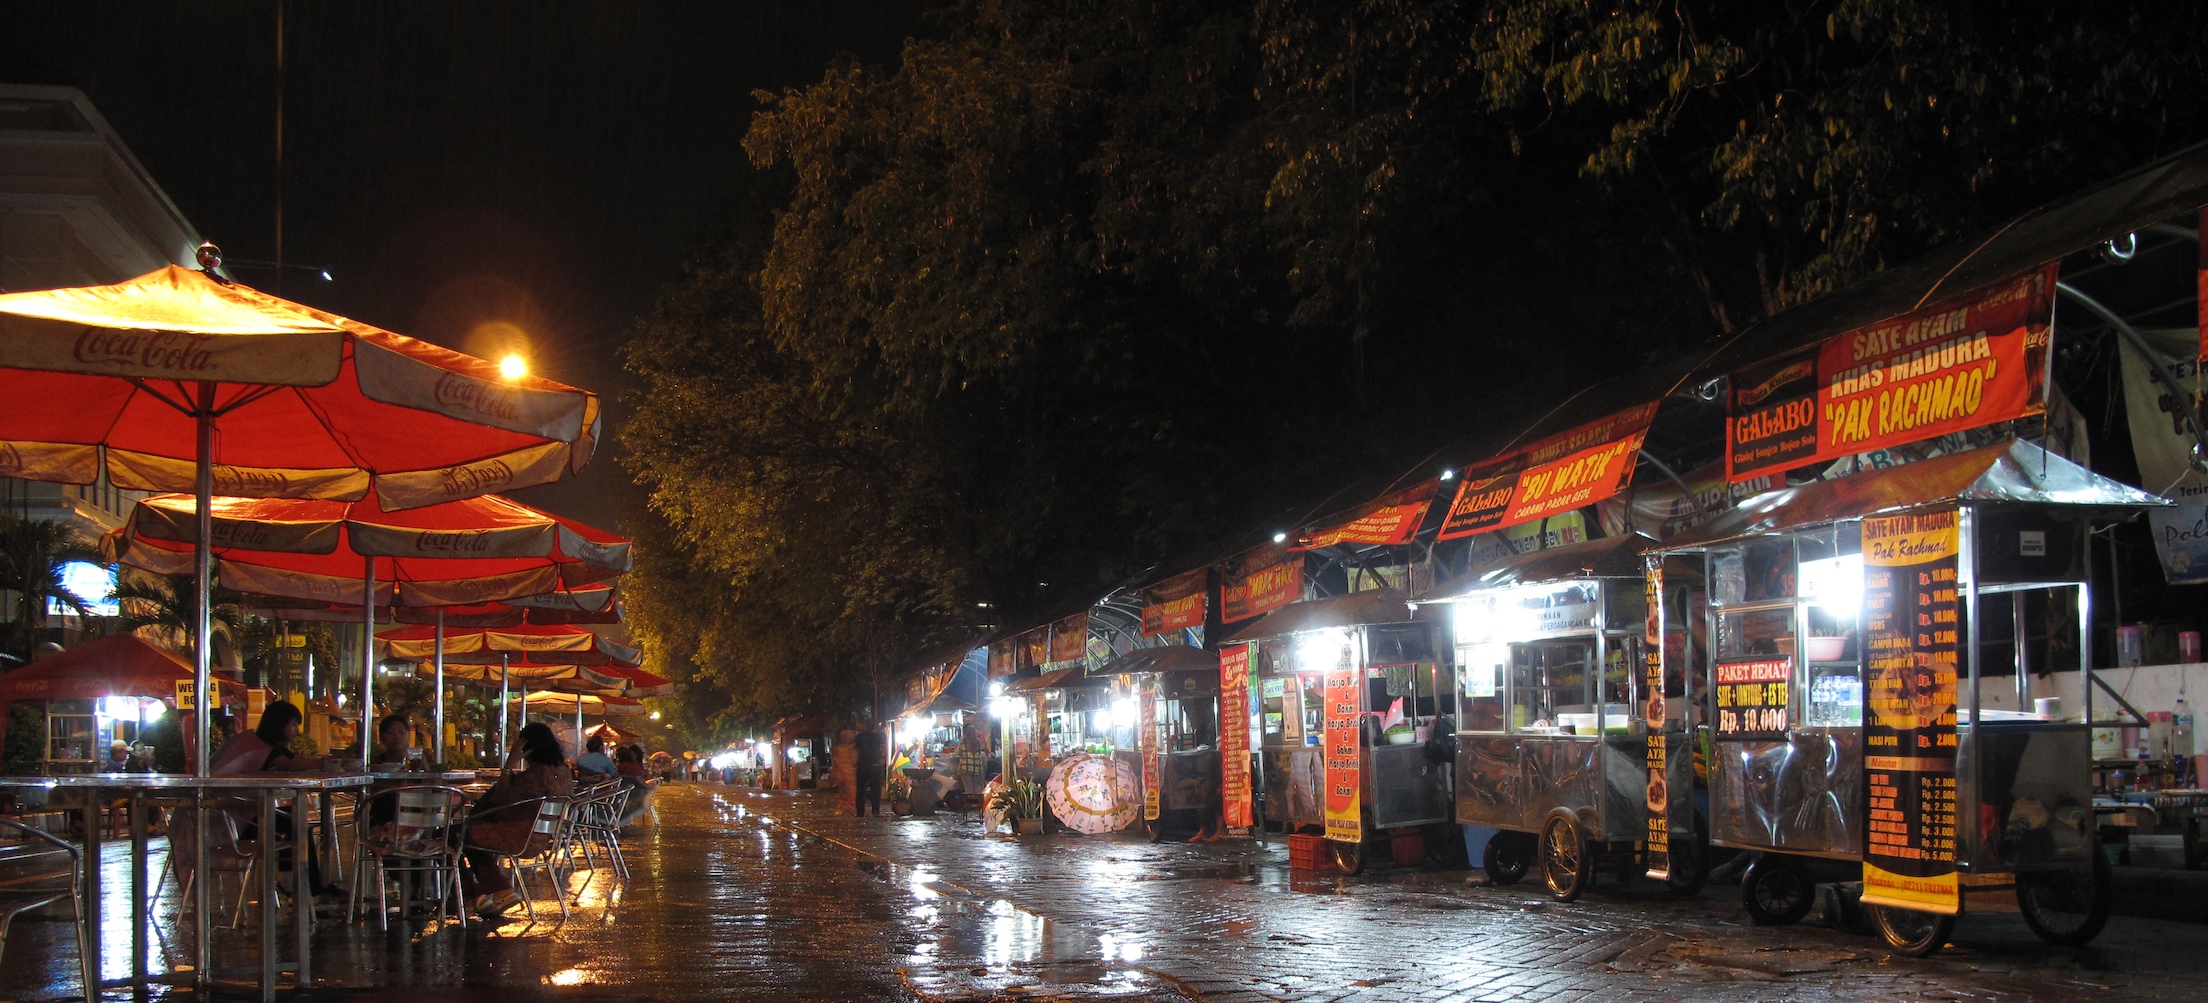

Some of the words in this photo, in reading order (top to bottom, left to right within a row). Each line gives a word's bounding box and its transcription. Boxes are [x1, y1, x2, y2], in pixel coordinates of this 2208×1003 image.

[1853, 323, 1903, 362] SATE
[1905, 306, 1969, 347] AYAM
[73, 327, 218, 371] Coca-Cola
[1830, 360, 1884, 400] KHAS
[1889, 330, 1992, 383] MADURA
[2149, 363, 2185, 384] STE
[434, 371, 518, 421] Coca-Cola
[1736, 397, 1815, 444] GALABO
[1825, 395, 1873, 446] "PAK
[1522, 469, 1552, 504] "BU
[1550, 441, 1626, 495] WATIK"
[1456, 487, 1513, 516] GALABO
[1545, 494, 1573, 512] PASAR
[1571, 487, 1593, 504] GEDE
[1866, 519, 1888, 540] SATE
[1889, 515, 1914, 537] AYAM
[1917, 511, 1955, 532] MADURA
[416, 530, 492, 553] Coca-Cola
[1873, 541, 1895, 561] Pak
[1897, 535, 1949, 558] Rachmad
[521, 636, 560, 648] Coca-Cola
[1225, 665, 1233, 681] &
[1718, 664, 1750, 682] PAKET
[1751, 662, 1787, 680] HEMAT
[1327, 677, 1345, 689] Harjo
[1717, 685, 1732, 707] SATE
[1768, 683, 1777, 706] ES
[1336, 703, 1355, 714] Bakmi
[1327, 717, 1344, 730] Harjo
[1719, 709, 1740, 735] Rp.
[1744, 708, 1786, 731] 10.000
[1647, 735, 1665, 747] SATE
[1868, 736, 1883, 746] NASI
[1336, 745, 1355, 755] Bakmi
[1647, 749, 1666, 759] AYAM
[1328, 758, 1345, 771] Harjo
[1921, 777, 1933, 788] Rp.
[1336, 785, 1353, 796] Bakmi
[1921, 789, 1933, 800] Rp.
[1921, 801, 1933, 813] Rp.
[1648, 818, 1667, 831] SATE
[1921, 813, 1933, 825] Rp.
[1648, 831, 1668, 844] AYAM
[1921, 825, 1933, 837] Rp.
[1921, 838, 1933, 849] Rp.
[1920, 850, 1932, 861] Rp.
[1867, 875, 1894, 888] Pesanan
